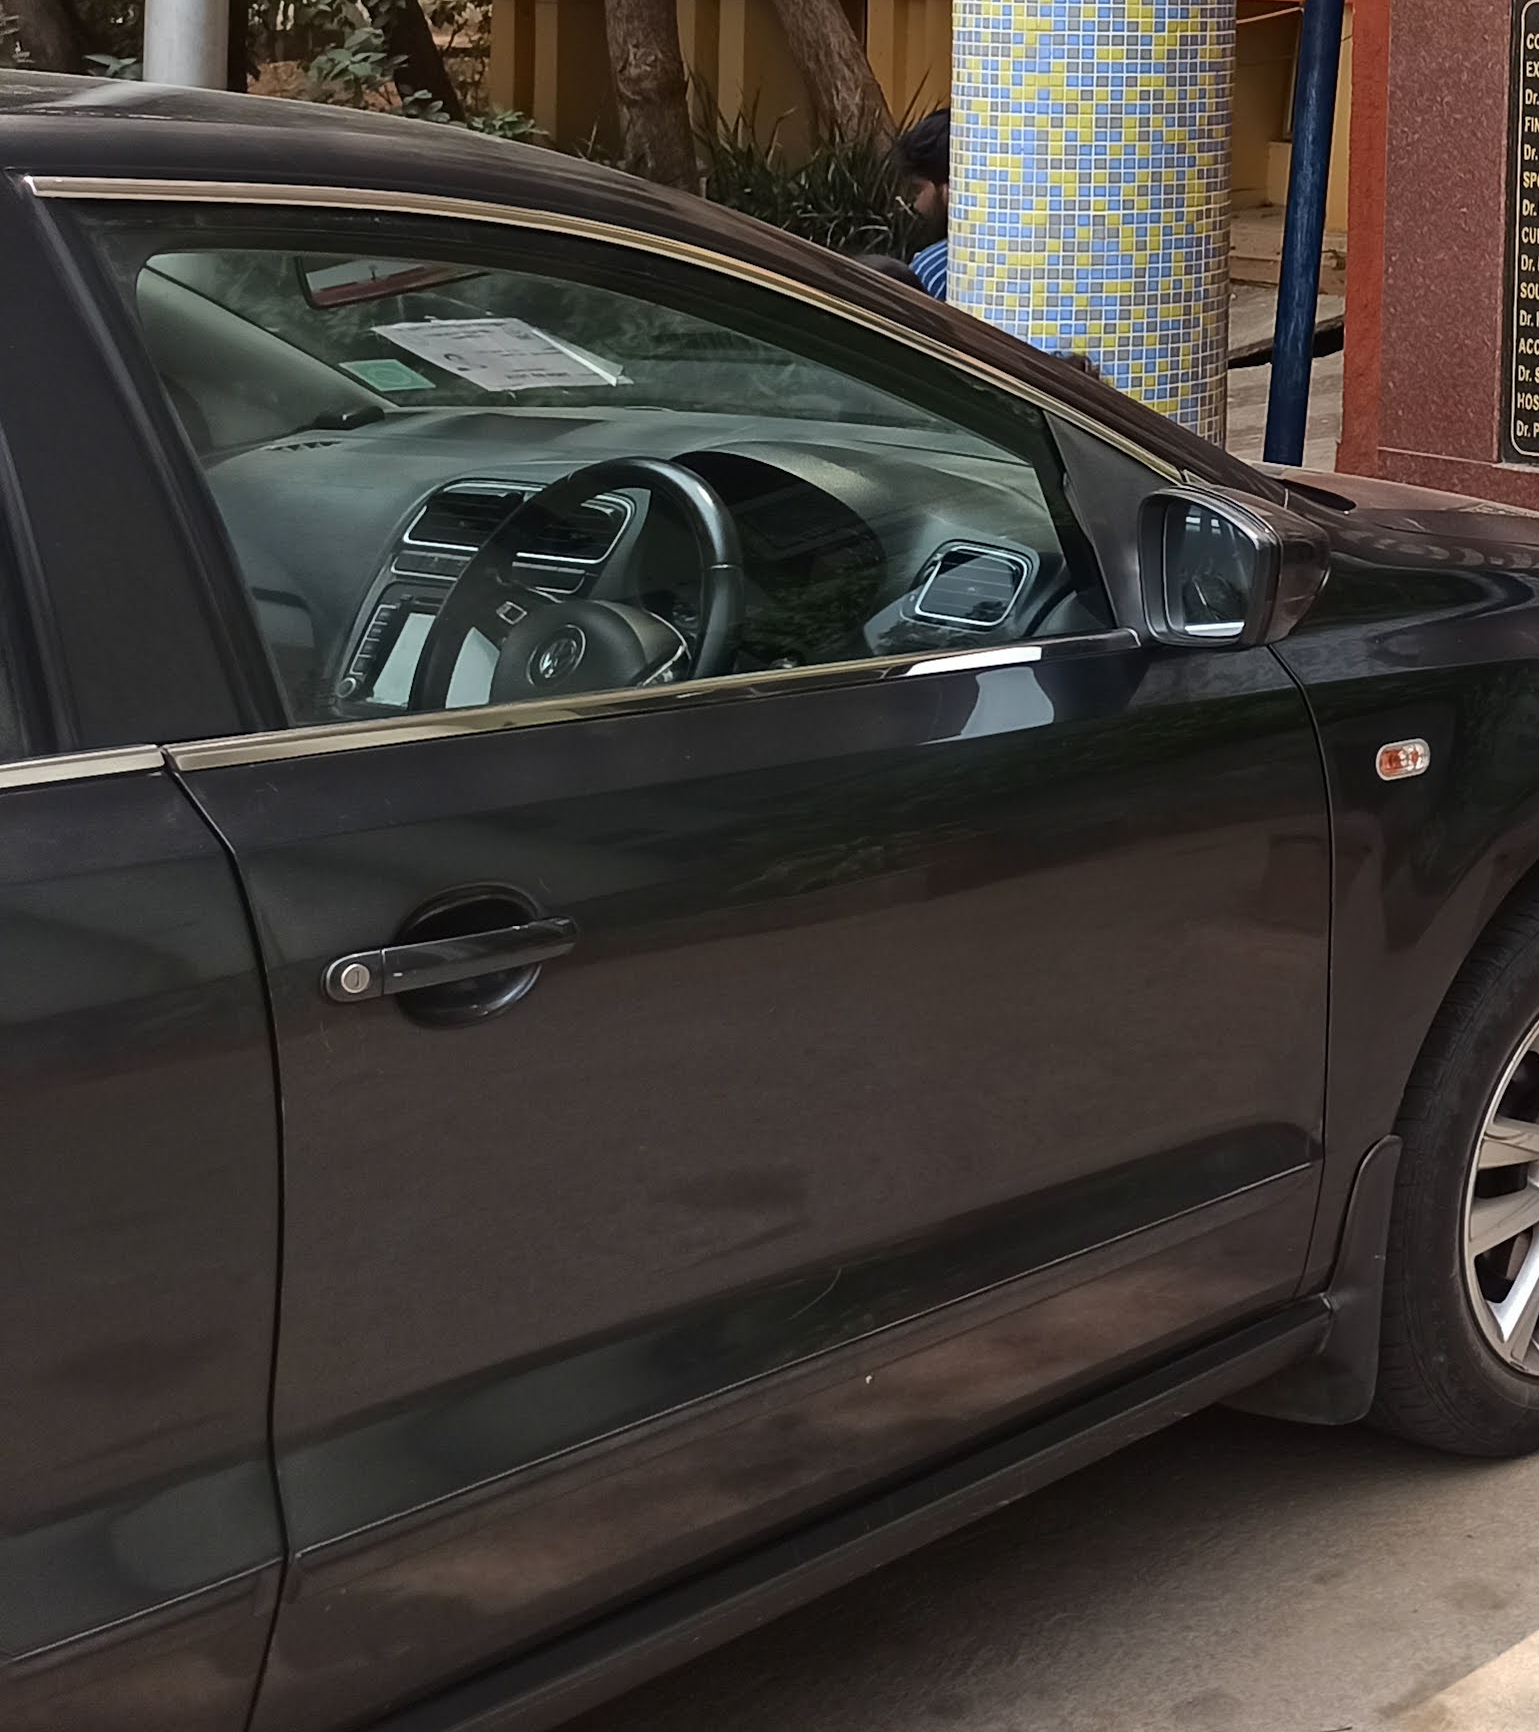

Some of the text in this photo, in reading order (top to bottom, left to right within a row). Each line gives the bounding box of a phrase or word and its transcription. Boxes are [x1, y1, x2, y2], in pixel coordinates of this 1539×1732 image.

[1523, 144, 1538, 161] Dr.
[1522, 200, 1537, 217] Dr.
[1519, 309, 1534, 327] Dr.
[1518, 365, 1532, 383] Dr.
[1516, 420, 1531, 438] Dr.
